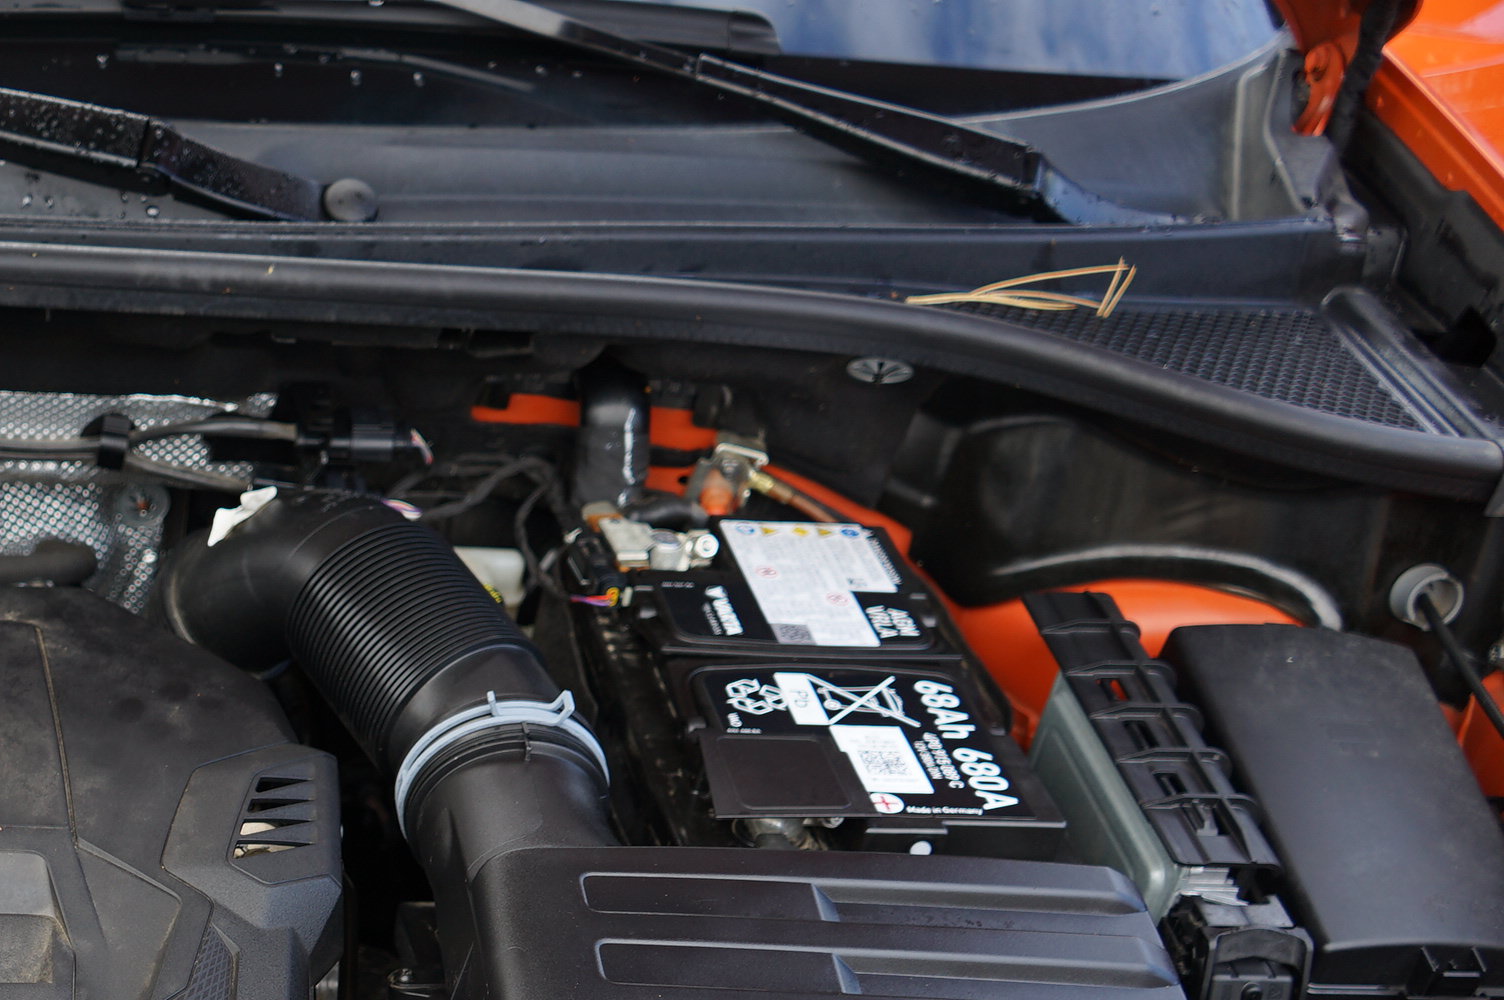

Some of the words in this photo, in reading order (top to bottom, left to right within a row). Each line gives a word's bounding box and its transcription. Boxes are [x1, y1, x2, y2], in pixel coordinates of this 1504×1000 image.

[865, 605, 899, 639] VRLA
[886, 607, 921, 637] AGM
[913, 679, 976, 740] 68Ah
[952, 747, 1019, 811] 680A
[906, 805, 931, 814] Made
[932, 805, 941, 814] in
[942, 806, 983, 816] Germany
